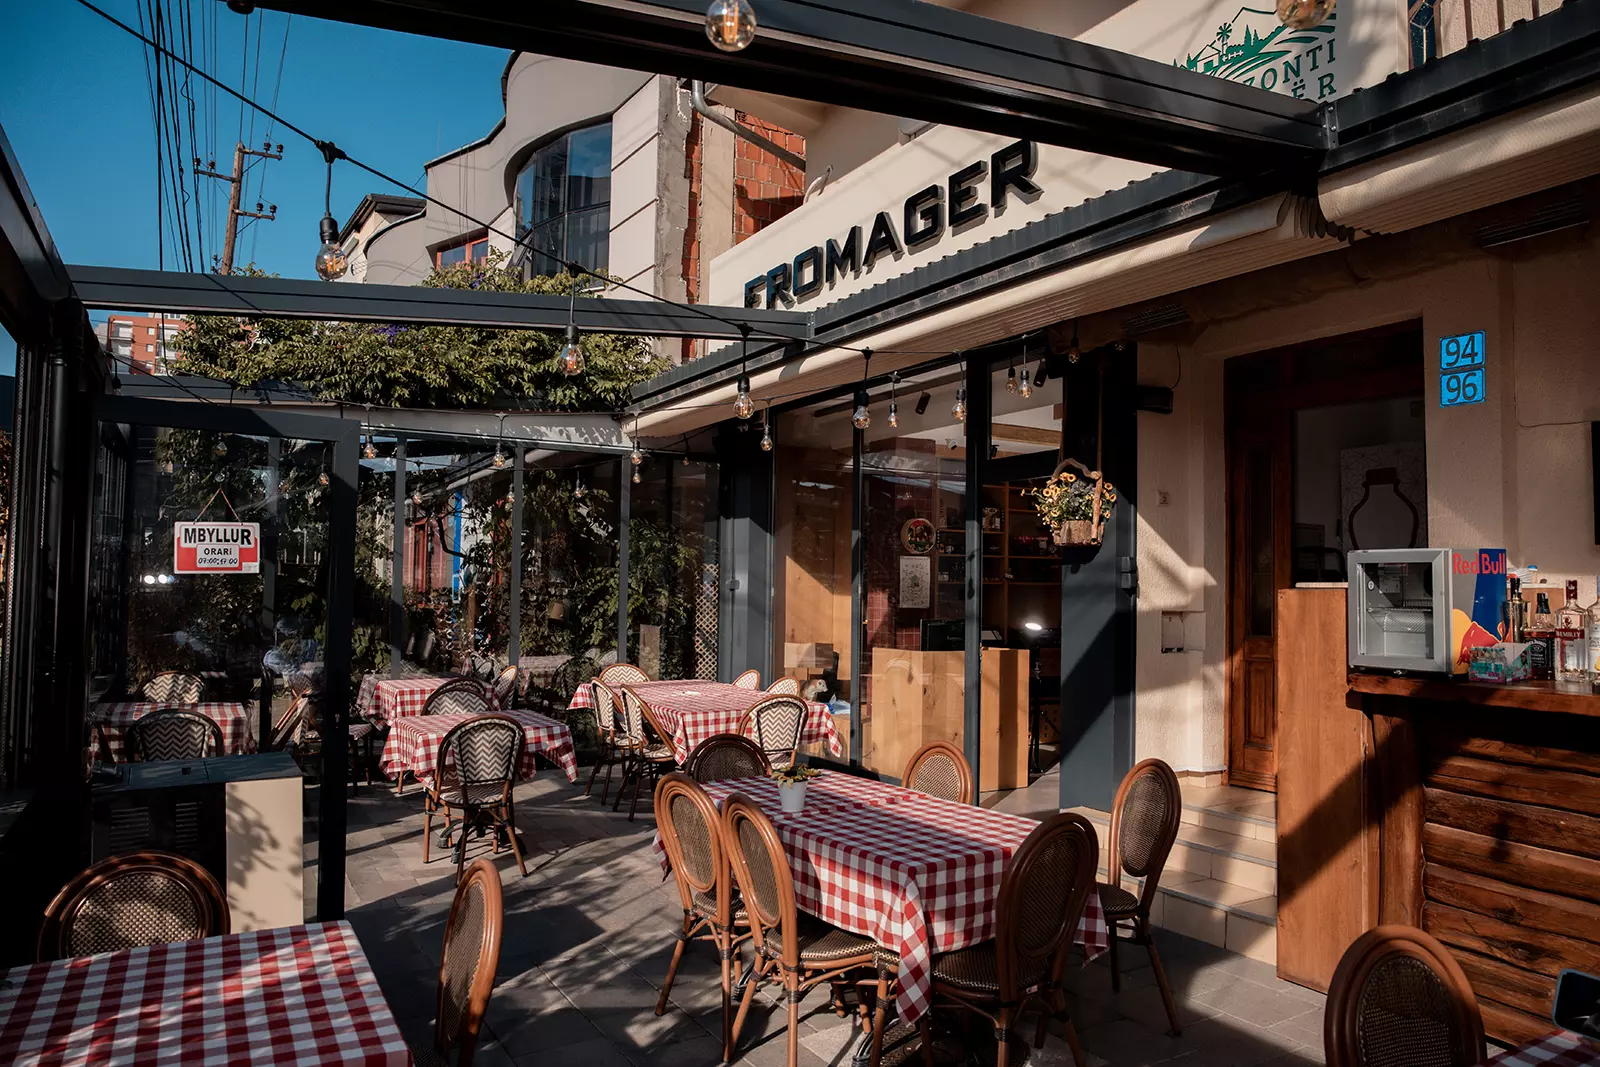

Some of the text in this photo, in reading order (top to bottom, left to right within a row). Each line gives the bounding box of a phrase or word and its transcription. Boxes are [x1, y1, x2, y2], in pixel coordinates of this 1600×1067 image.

[744, 139, 1045, 310] FROMAGER
[1445, 335, 1478, 367] 94
[1446, 372, 1478, 403] 96
[184, 528, 252, 545] MBYLLUR
[1453, 552, 1506, 575] Red Bull
